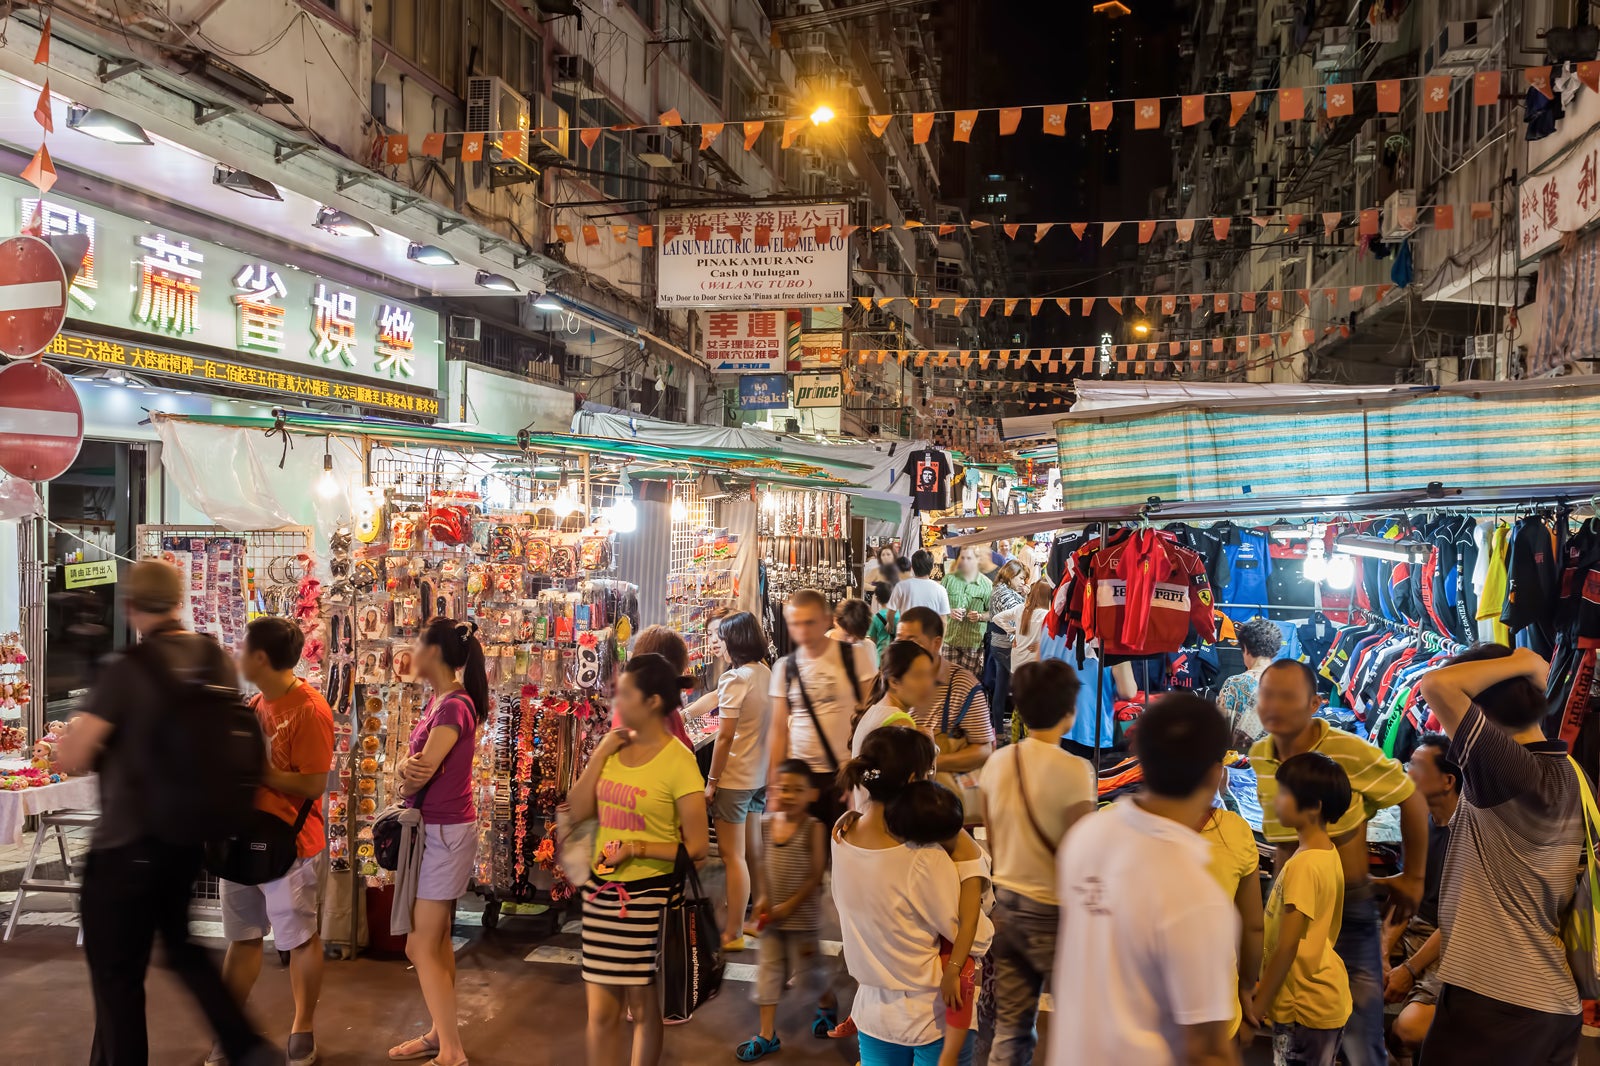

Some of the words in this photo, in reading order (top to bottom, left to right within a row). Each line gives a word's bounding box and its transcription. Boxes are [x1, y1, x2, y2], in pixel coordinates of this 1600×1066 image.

[663, 240, 680, 255] LAI
[682, 239, 701, 255] SUN
[704, 238, 752, 254] ELECTRIC
[697, 256, 814, 267] PINAKAMURANG
[710, 269, 738, 277] Cash
[753, 268, 800, 277] hulugan
[660, 294, 673, 303] May
[701, 293, 716, 301] Door
[743, 292, 751, 300] Sa
[782, 291, 795, 299] free
[797, 291, 822, 300] delivery
[833, 290, 845, 298] HK
[709, 313, 776, 338] 幸運
[795, 382, 840, 406] prince
